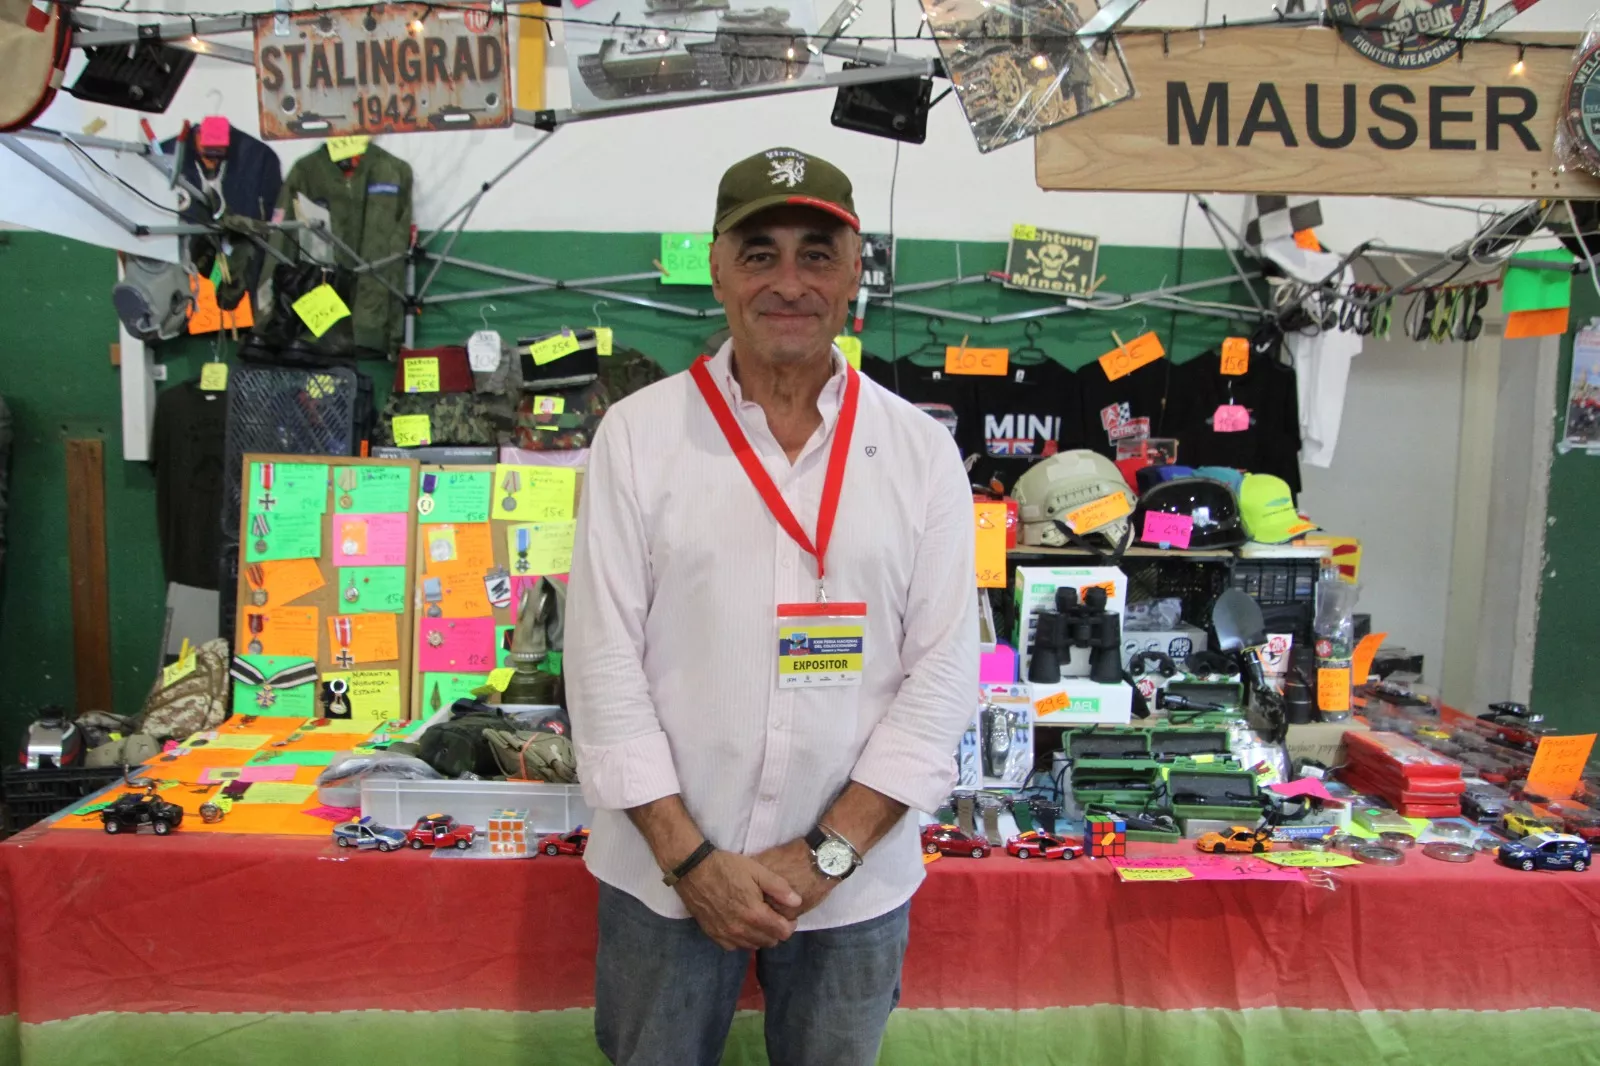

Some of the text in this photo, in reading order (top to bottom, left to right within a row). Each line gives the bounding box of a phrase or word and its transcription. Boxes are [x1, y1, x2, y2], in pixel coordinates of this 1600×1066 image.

[1416, 5, 1455, 32] GUN
[260, 35, 501, 92] STALINGRAD
[1352, 35, 1457, 66] FIGHTER WEAPONS
[352, 93, 417, 125] 1942
[1166, 81, 1541, 151] MAUSER
[1034, 230, 1094, 252] chtung
[793, 659, 849, 671] EXPOSITOR
[371, 709, 389, 721] 9€
